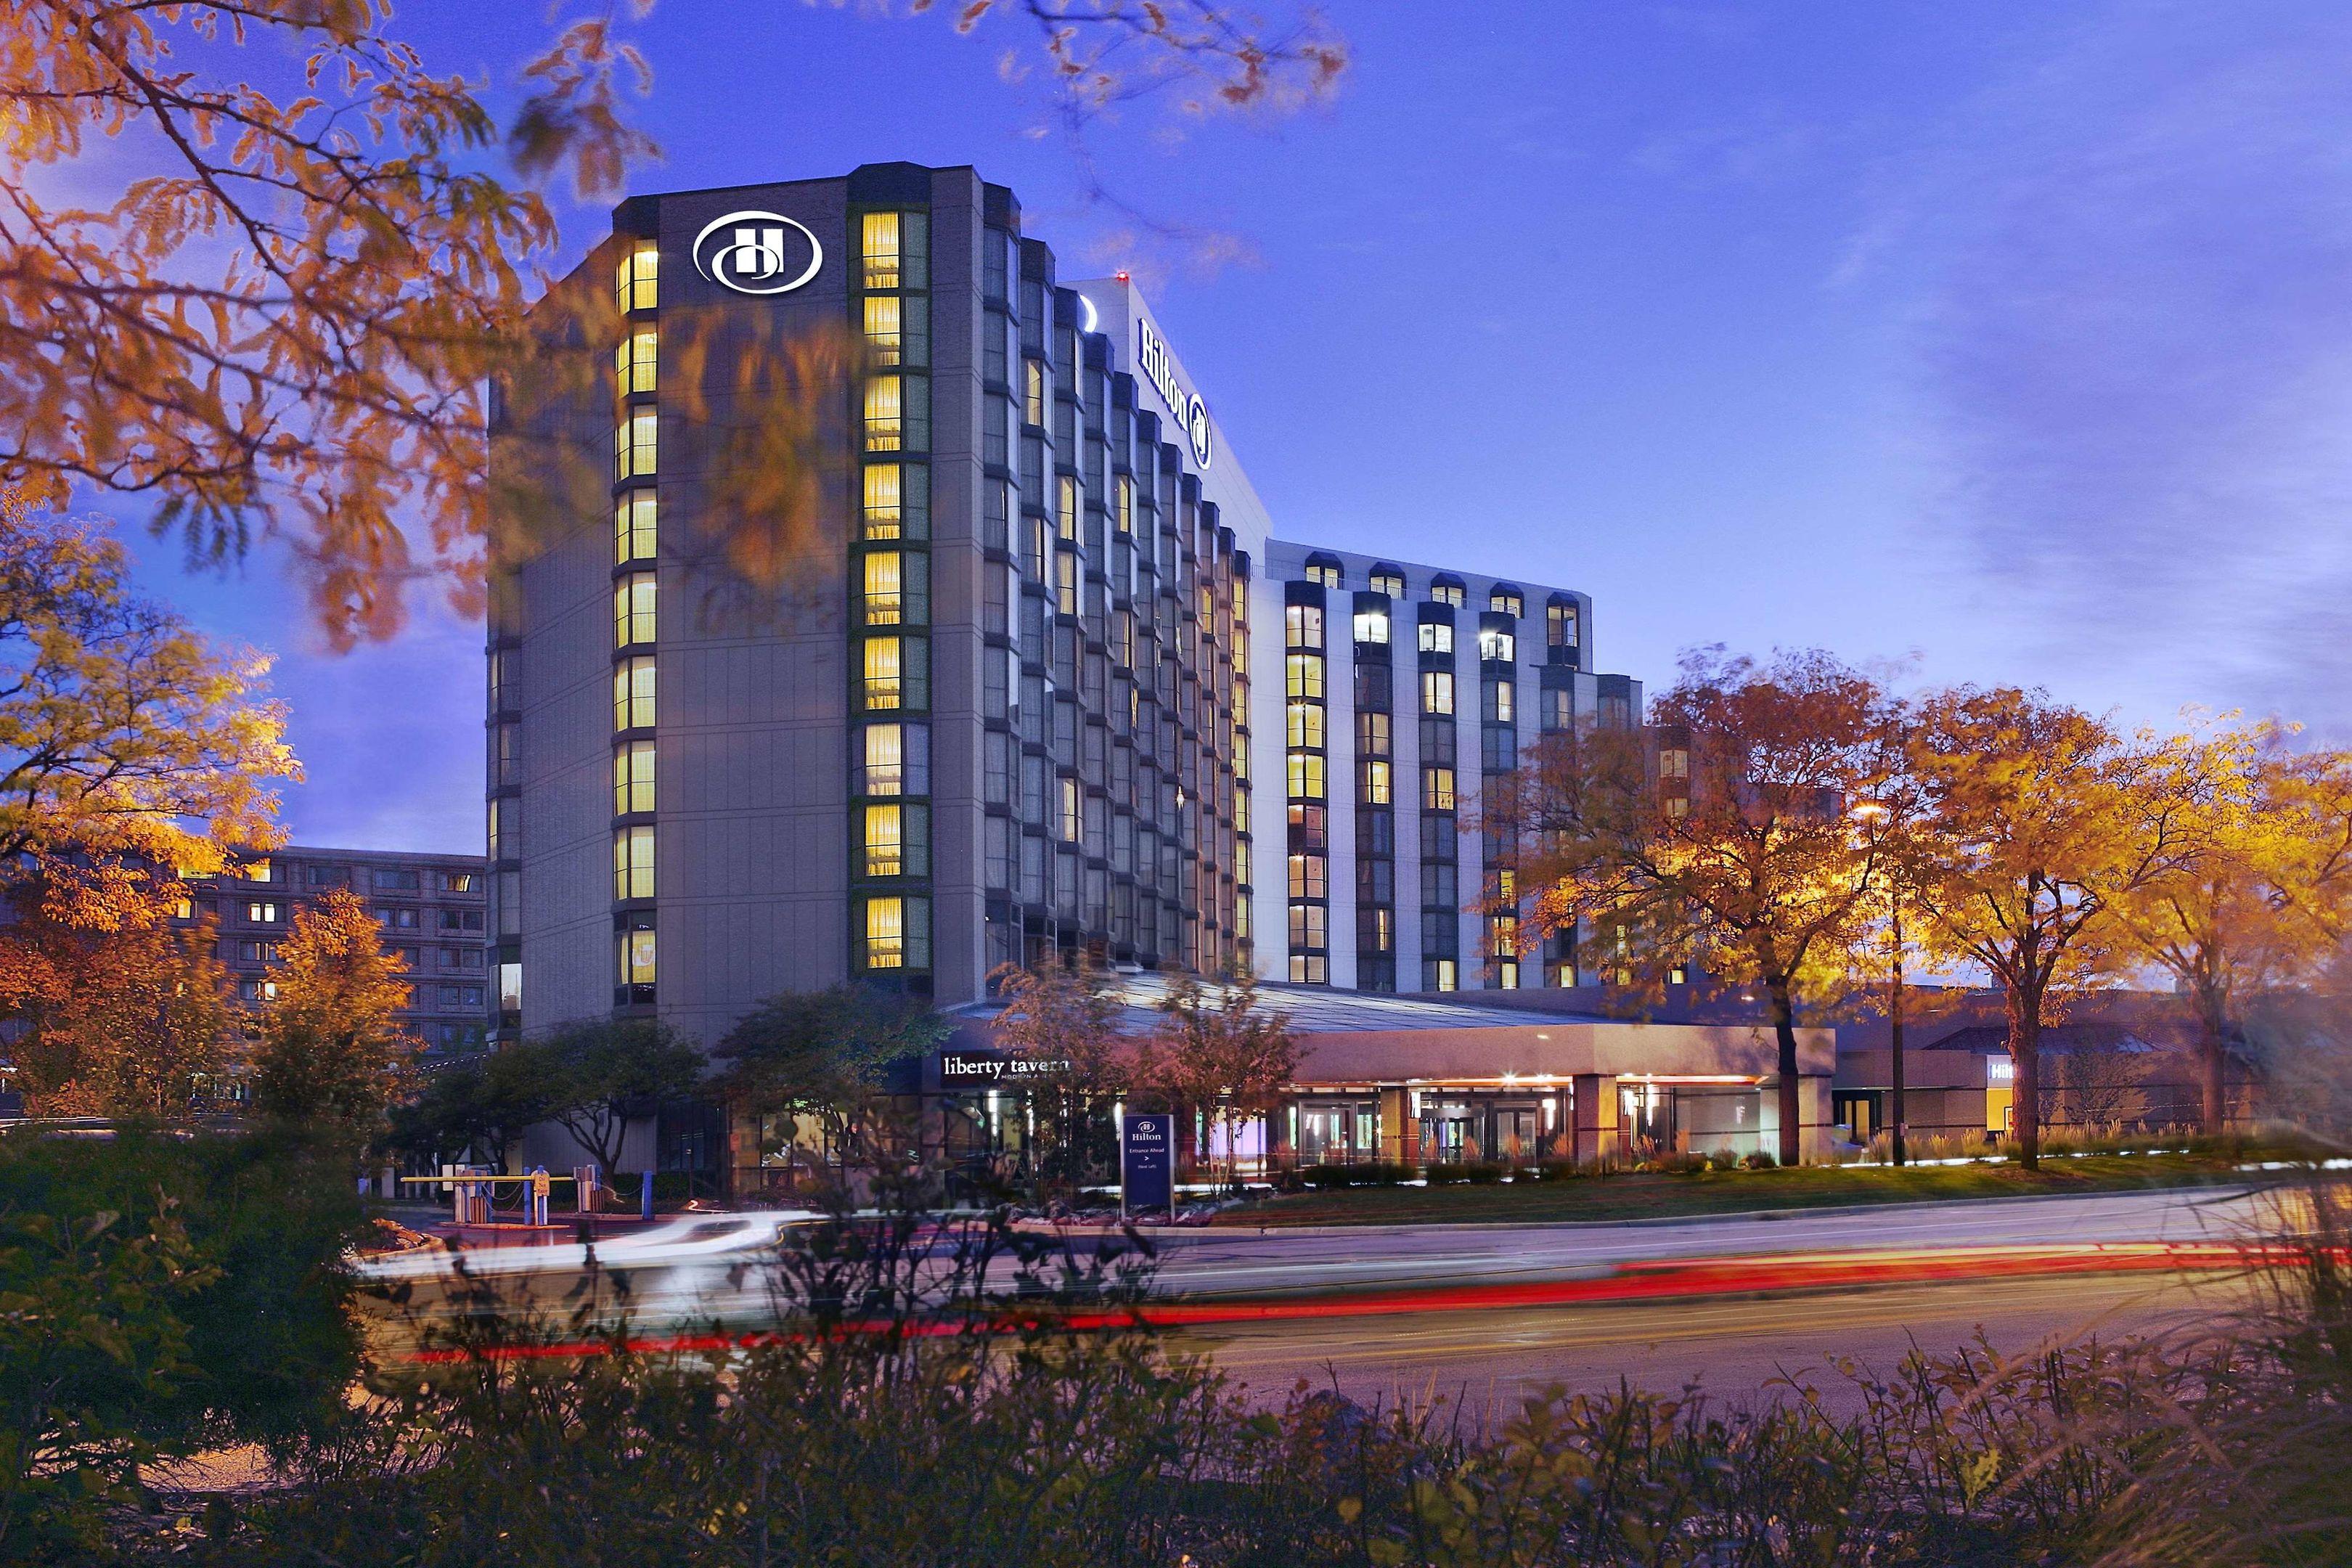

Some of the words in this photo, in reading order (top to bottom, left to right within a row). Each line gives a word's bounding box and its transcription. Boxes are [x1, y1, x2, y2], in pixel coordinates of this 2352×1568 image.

[1138, 318, 1188, 432] Hilton
[944, 1057, 1005, 1079] liberty
[1010, 1059, 1071, 1072] tavern
[1132, 1132, 1161, 1141] Hilton
